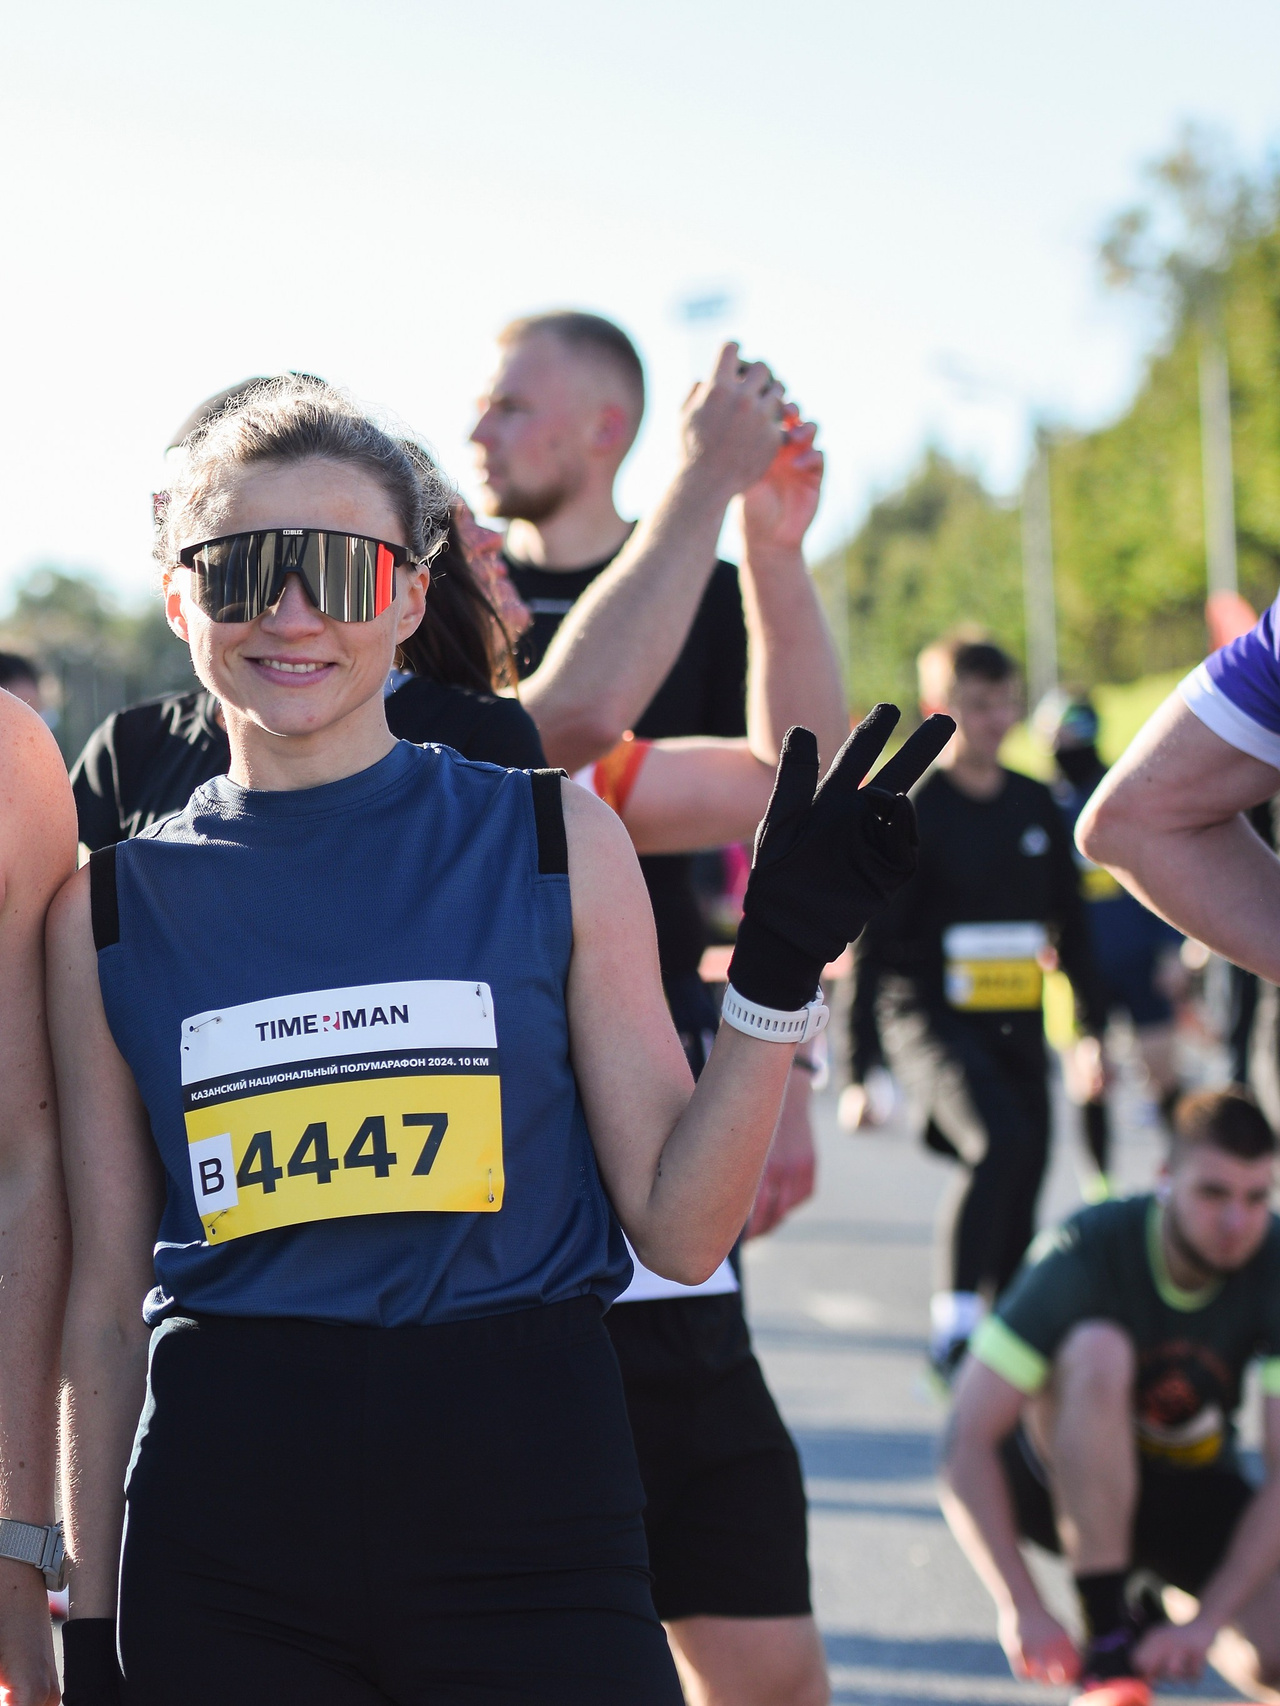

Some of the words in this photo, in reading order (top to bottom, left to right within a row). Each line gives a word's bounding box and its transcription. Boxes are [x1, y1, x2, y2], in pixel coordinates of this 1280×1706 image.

[191, 1079, 247, 1101] КАЗАНСКИЙ
[248, 1064, 338, 1088] НАЦИОНАЛЬНЫЙ
[340, 1058, 426, 1073] ПОЛУМАРАФОН
[428, 1058, 457, 1067] 2024.
[458, 1058, 471, 1067] 10
[472, 1057, 490, 1066] КМ
[198, 1157, 225, 1196] B
[236, 1112, 449, 1195] 4447
